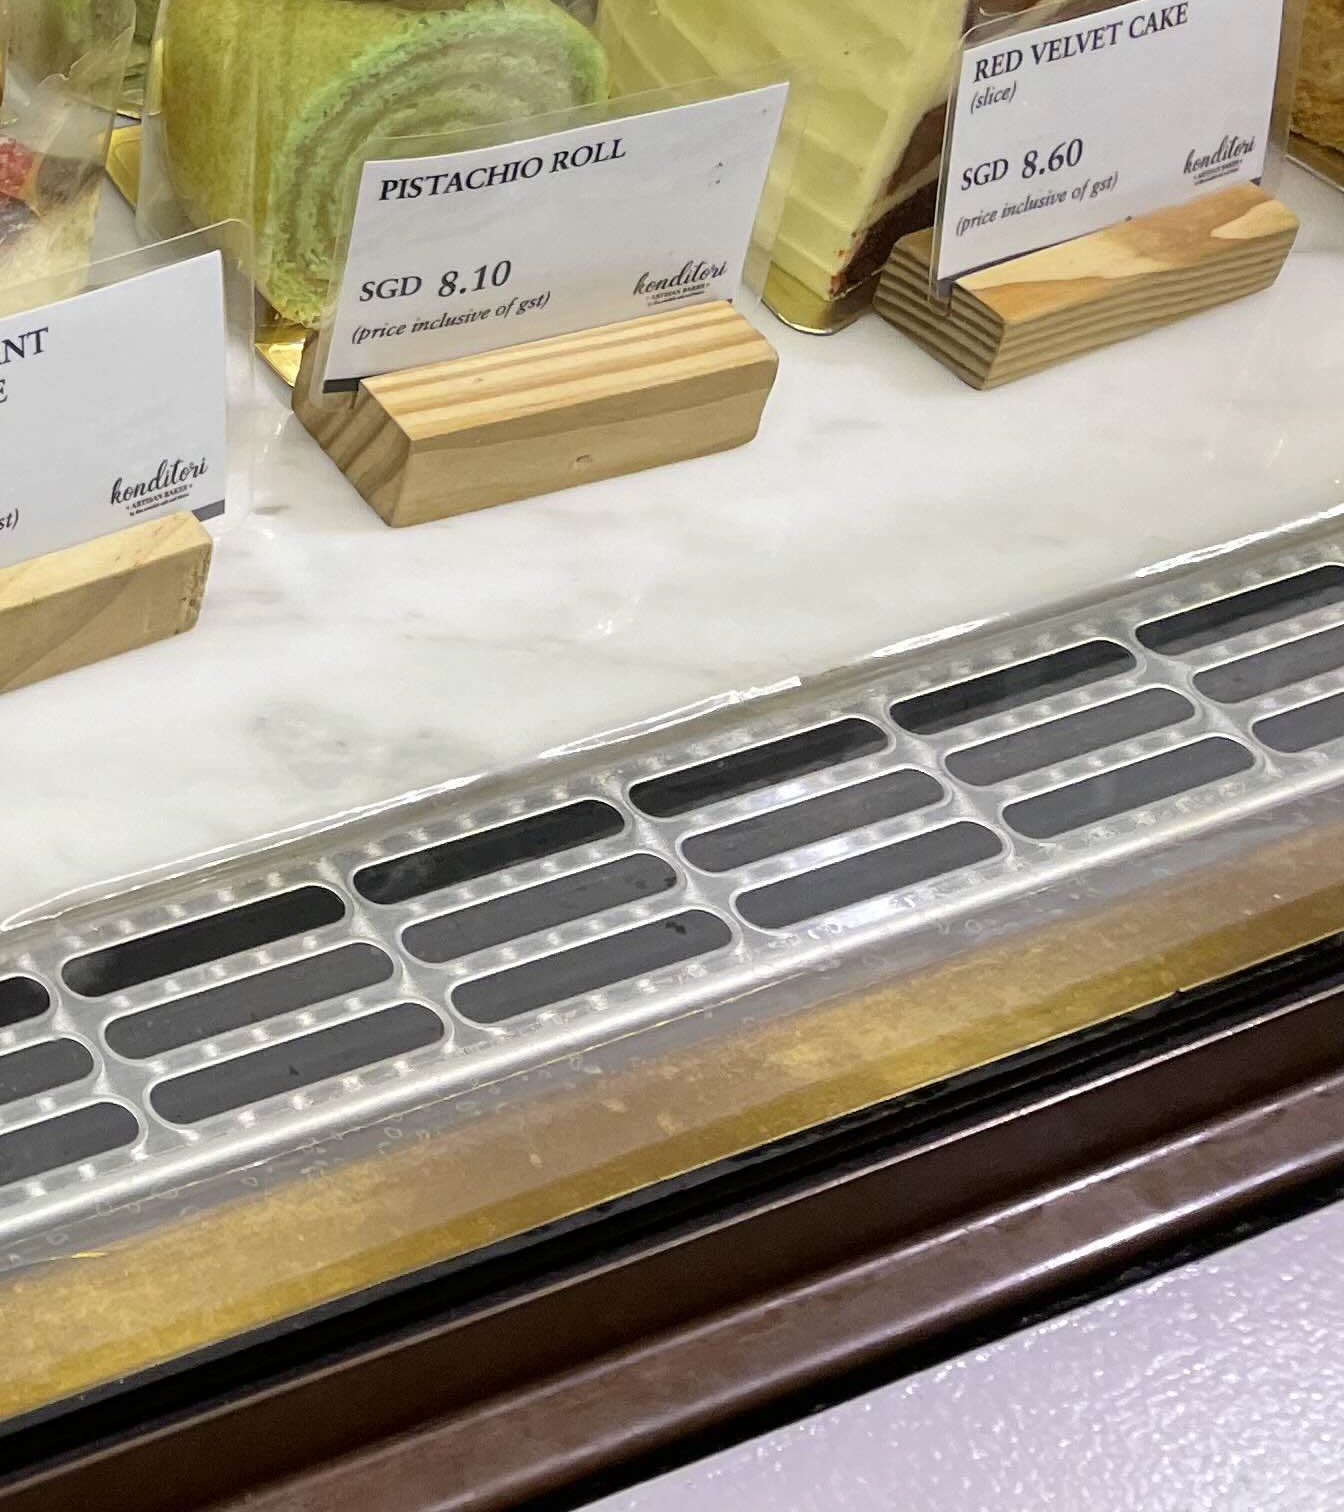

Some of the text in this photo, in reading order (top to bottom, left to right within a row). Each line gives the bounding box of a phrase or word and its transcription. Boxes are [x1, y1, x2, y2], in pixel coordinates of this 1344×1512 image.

[973, 2, 1189, 83] RED VELVET CAKE
[970, 81, 1017, 115] (slice)
[378, 137, 627, 201] PISTACHIO ROLL
[960, 138, 1084, 191] SGD 8.60
[1184, 135, 1255, 174] konditori
[955, 171, 1119, 237] (price inclusive of gst)
[359, 259, 513, 302] SGD 8.10
[633, 260, 727, 295] konditori
[351, 290, 551, 345] (price inclusive of gst)
[111, 457, 208, 504] konditori
